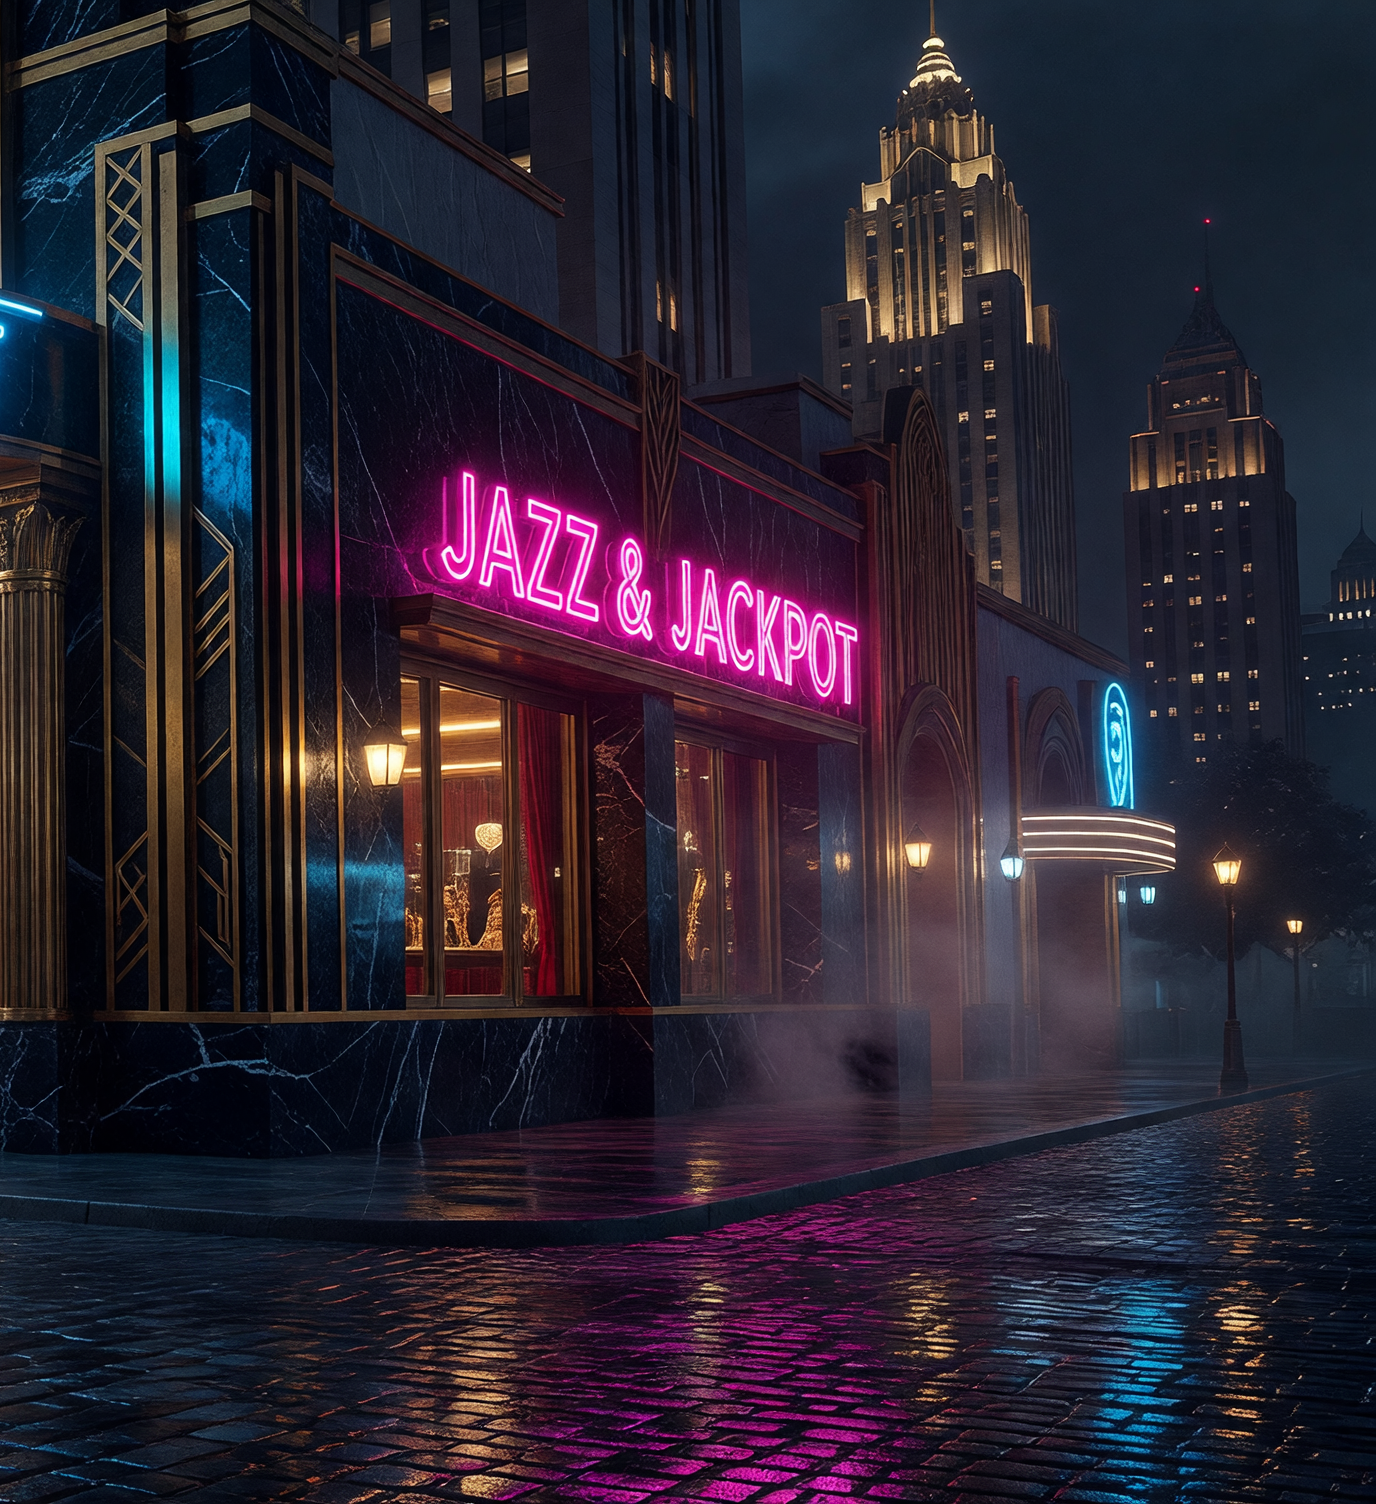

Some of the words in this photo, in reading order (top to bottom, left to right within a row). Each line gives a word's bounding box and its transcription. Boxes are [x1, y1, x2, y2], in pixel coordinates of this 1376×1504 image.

[441, 471, 599, 622] JAZZ
[617, 538, 653, 641] &
[671, 560, 858, 704] JACKPOT
